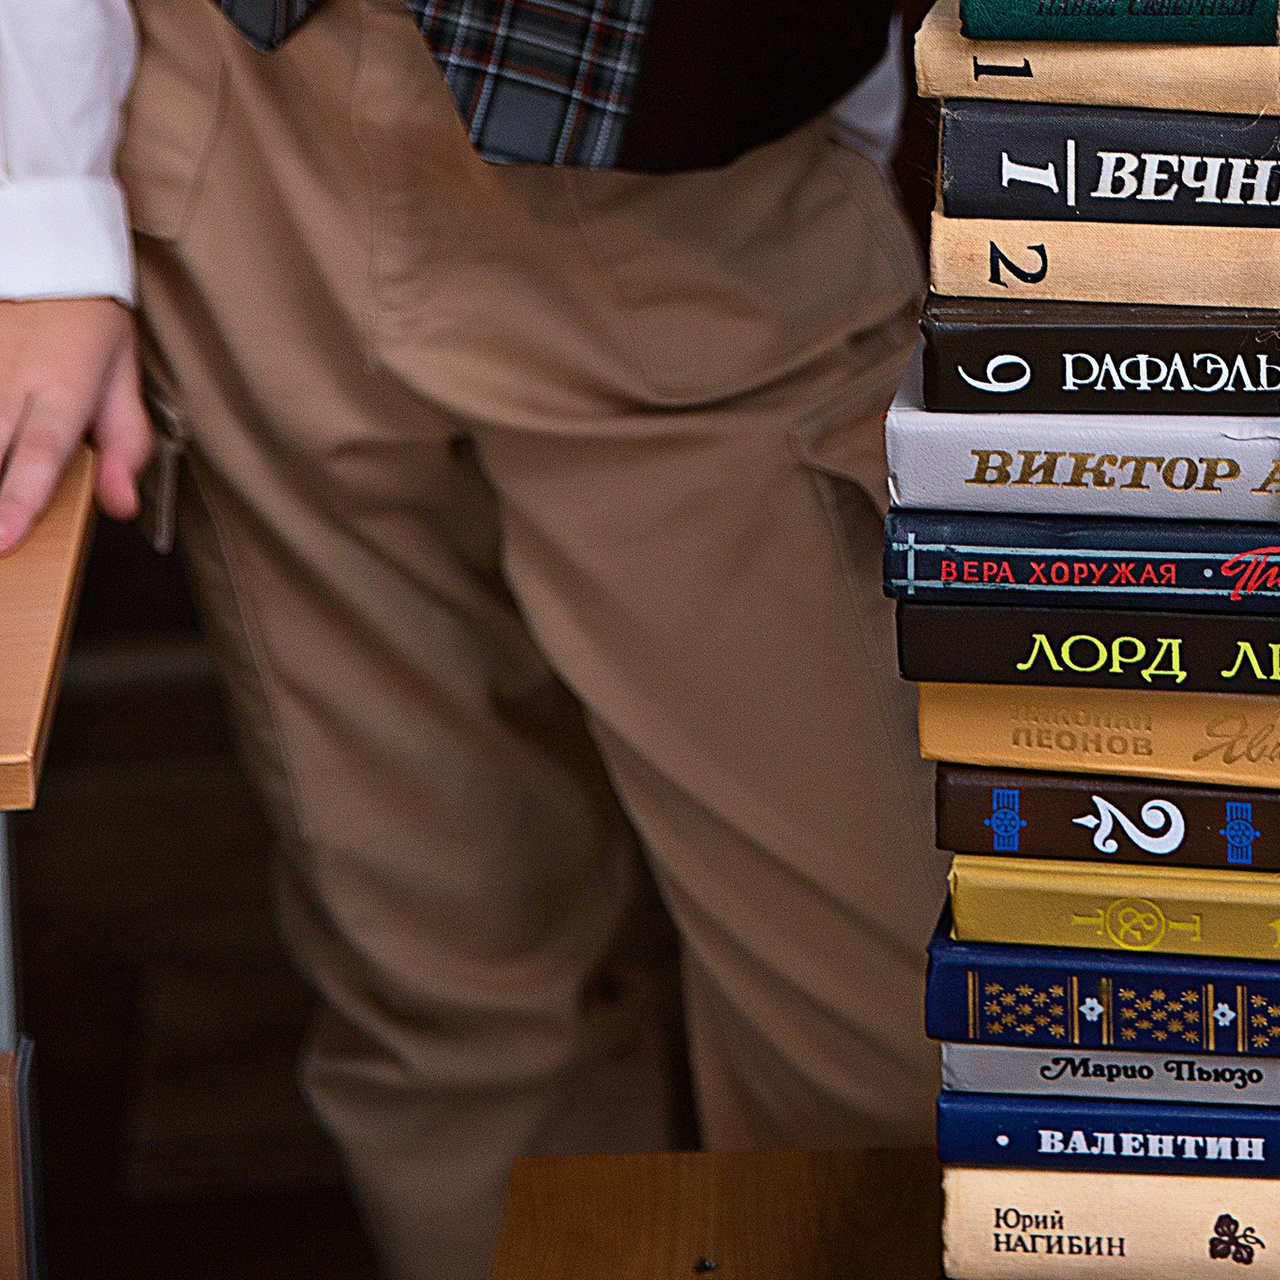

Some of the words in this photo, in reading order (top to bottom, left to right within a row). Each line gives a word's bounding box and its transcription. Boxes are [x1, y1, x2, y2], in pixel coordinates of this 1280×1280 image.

[973, 55, 1034, 82] 1
[988, 240, 1049, 288] 2
[964, 449, 1242, 494] ВИКТОР
[940, 559, 1015, 584] ВЕРА
[1028, 560, 1177, 586] ХОРУЖАЯ
[1016, 634, 1188, 685] ЛОРД
[1040, 1056, 1154, 1083] Марио
[1163, 1058, 1264, 1090] Пьюзо
[1037, 1128, 1266, 1162] ВАЛЕНТИН
[994, 1207, 1064, 1232] Юрий
[993, 1233, 1126, 1258] НАГИБИН
